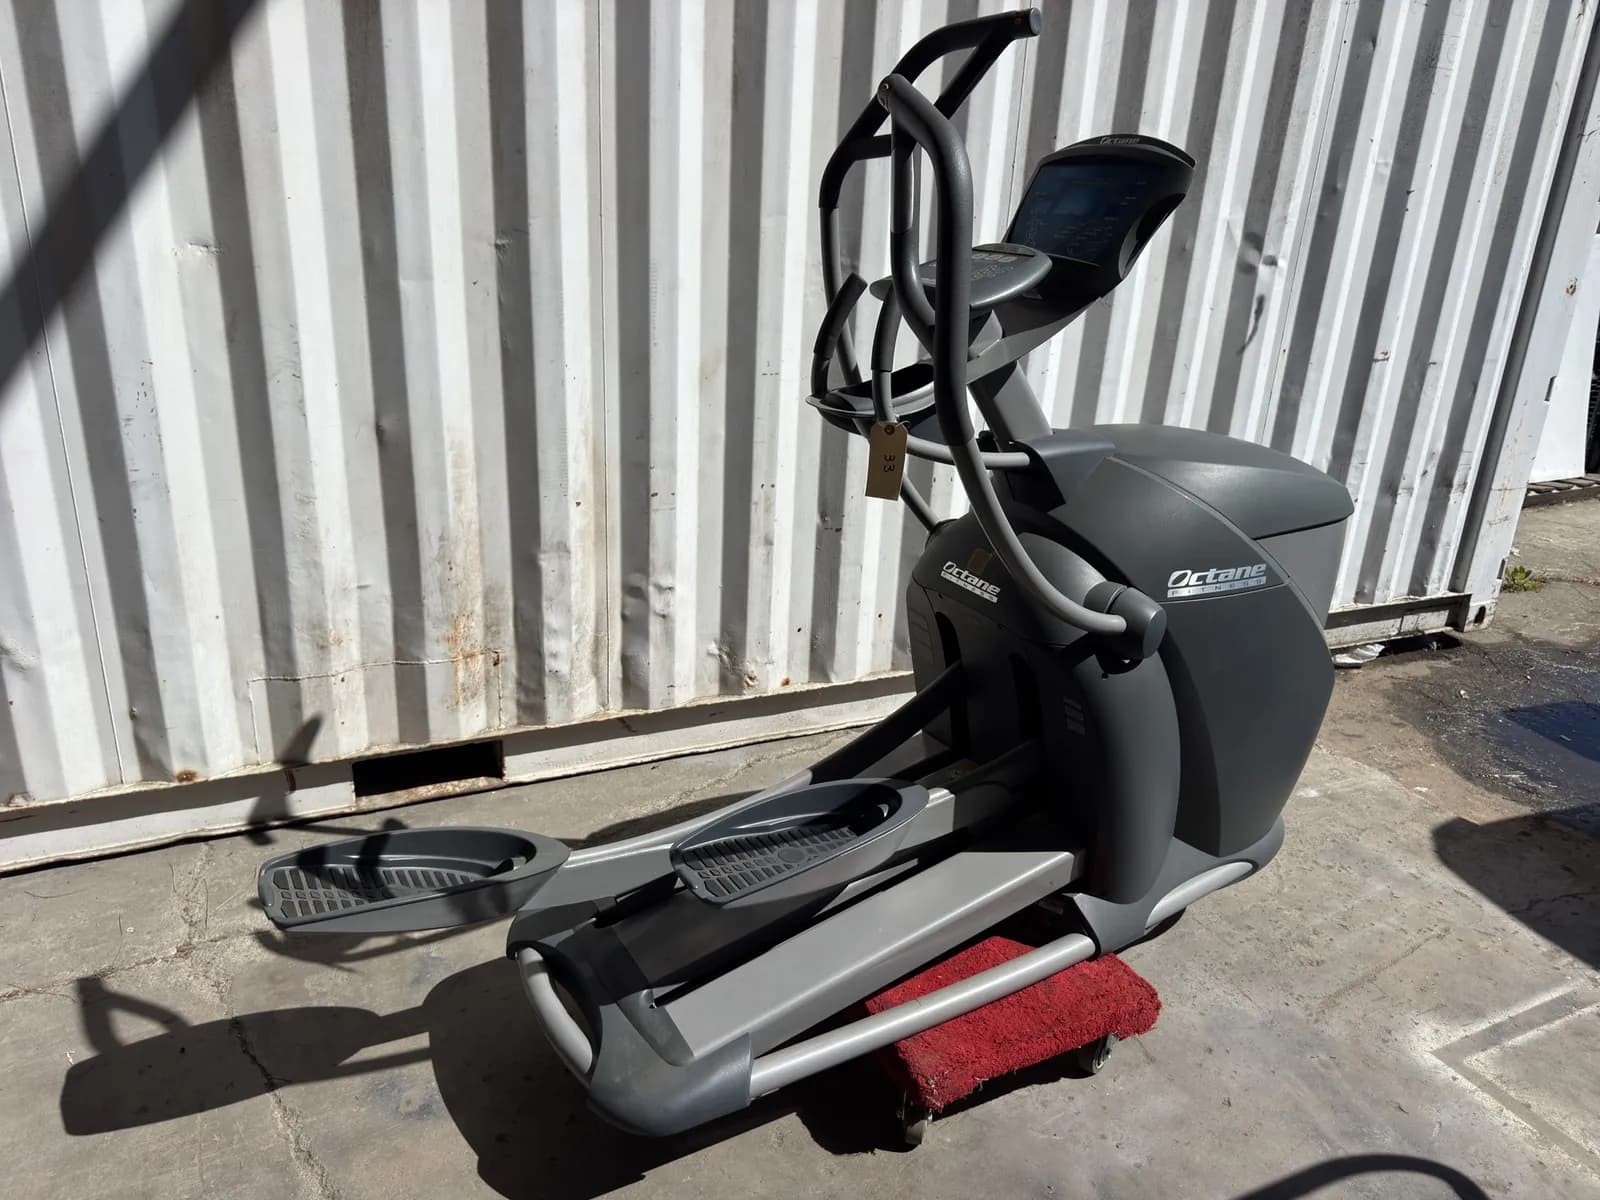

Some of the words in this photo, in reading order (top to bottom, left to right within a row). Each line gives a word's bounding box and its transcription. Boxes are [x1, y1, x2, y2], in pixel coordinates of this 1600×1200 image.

[1100, 136, 1140, 145] Octane
[883, 454, 896, 473] 33
[942, 561, 1001, 596] Octane
[1167, 563, 1267, 588] Octane
